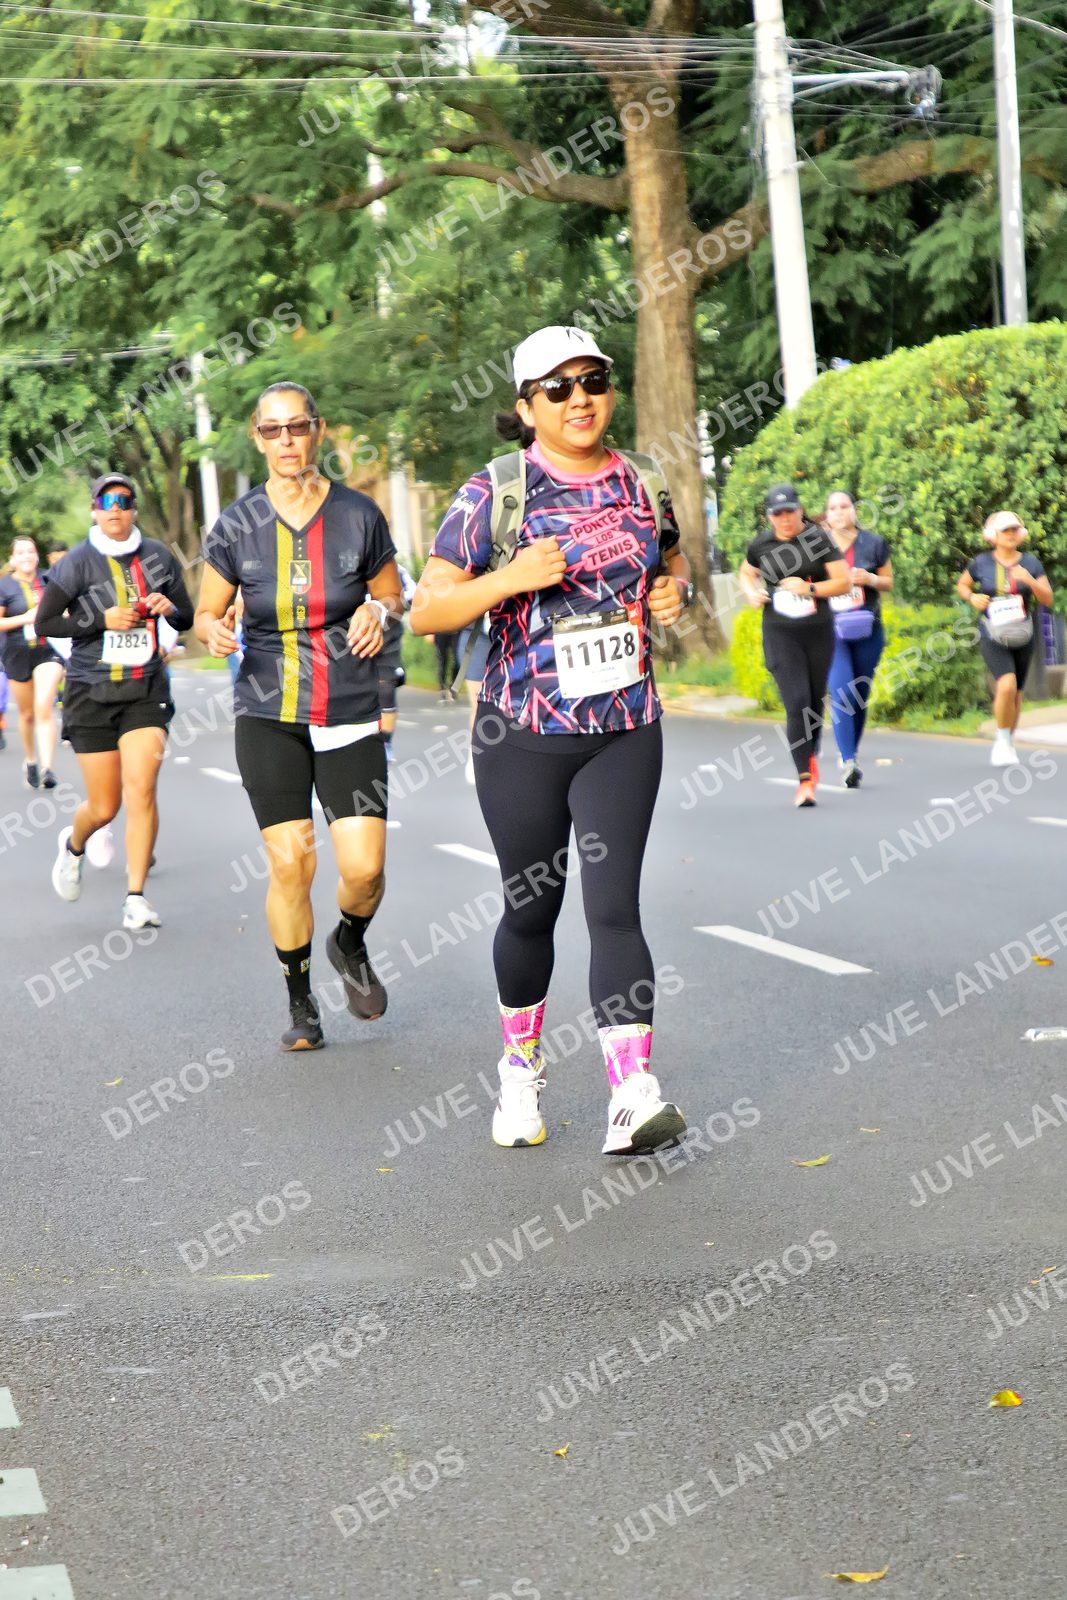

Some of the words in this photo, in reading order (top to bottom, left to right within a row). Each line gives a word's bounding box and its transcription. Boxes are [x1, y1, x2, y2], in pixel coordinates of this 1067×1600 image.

[574, 510, 619, 538] PONTE
[596, 531, 614, 544] LOS
[587, 539, 633, 567] TENIS
[110, 634, 148, 649] 12824
[561, 631, 636, 669] 11128
